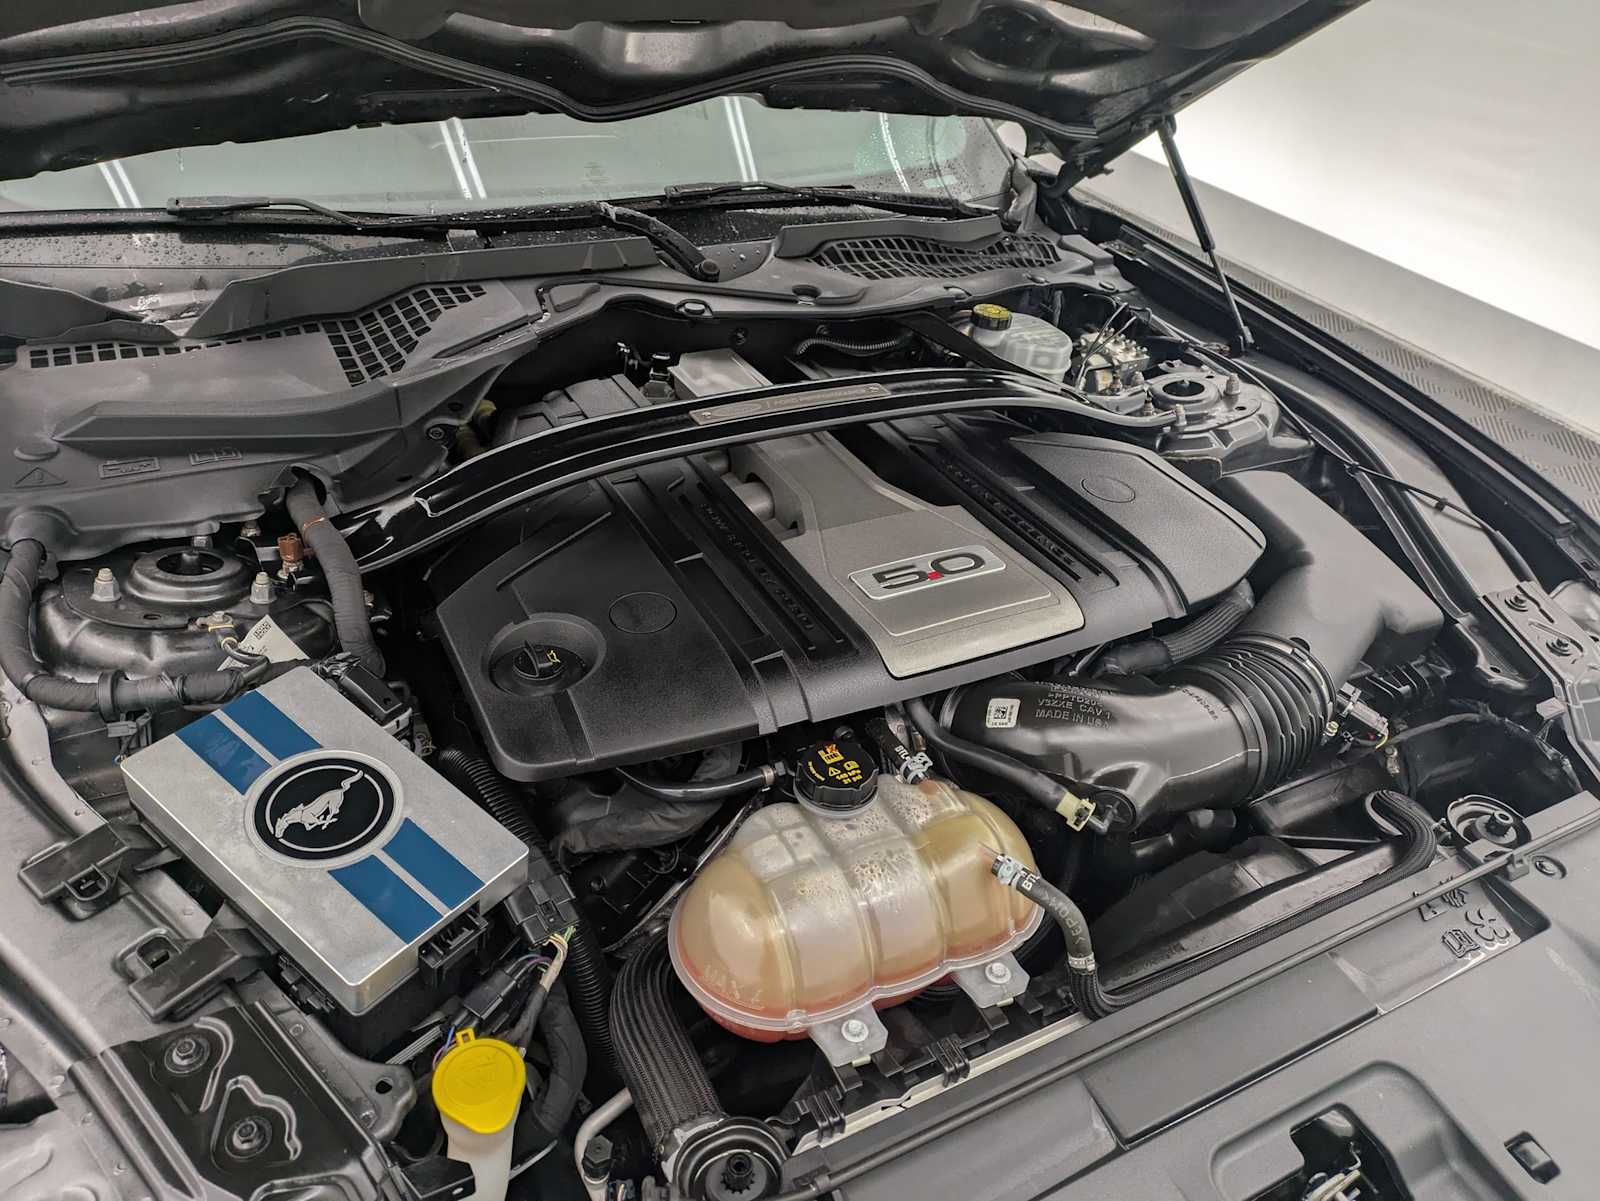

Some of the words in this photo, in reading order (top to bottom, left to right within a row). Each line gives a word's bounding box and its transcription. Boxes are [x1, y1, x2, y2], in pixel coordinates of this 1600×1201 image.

[872, 552, 985, 590] 5.0
[1036, 708, 1070, 720] MADE
[1072, 713, 1085, 724] IN
[1087, 717, 1111, 729] USA
[1080, 704, 1102, 716] CAV
